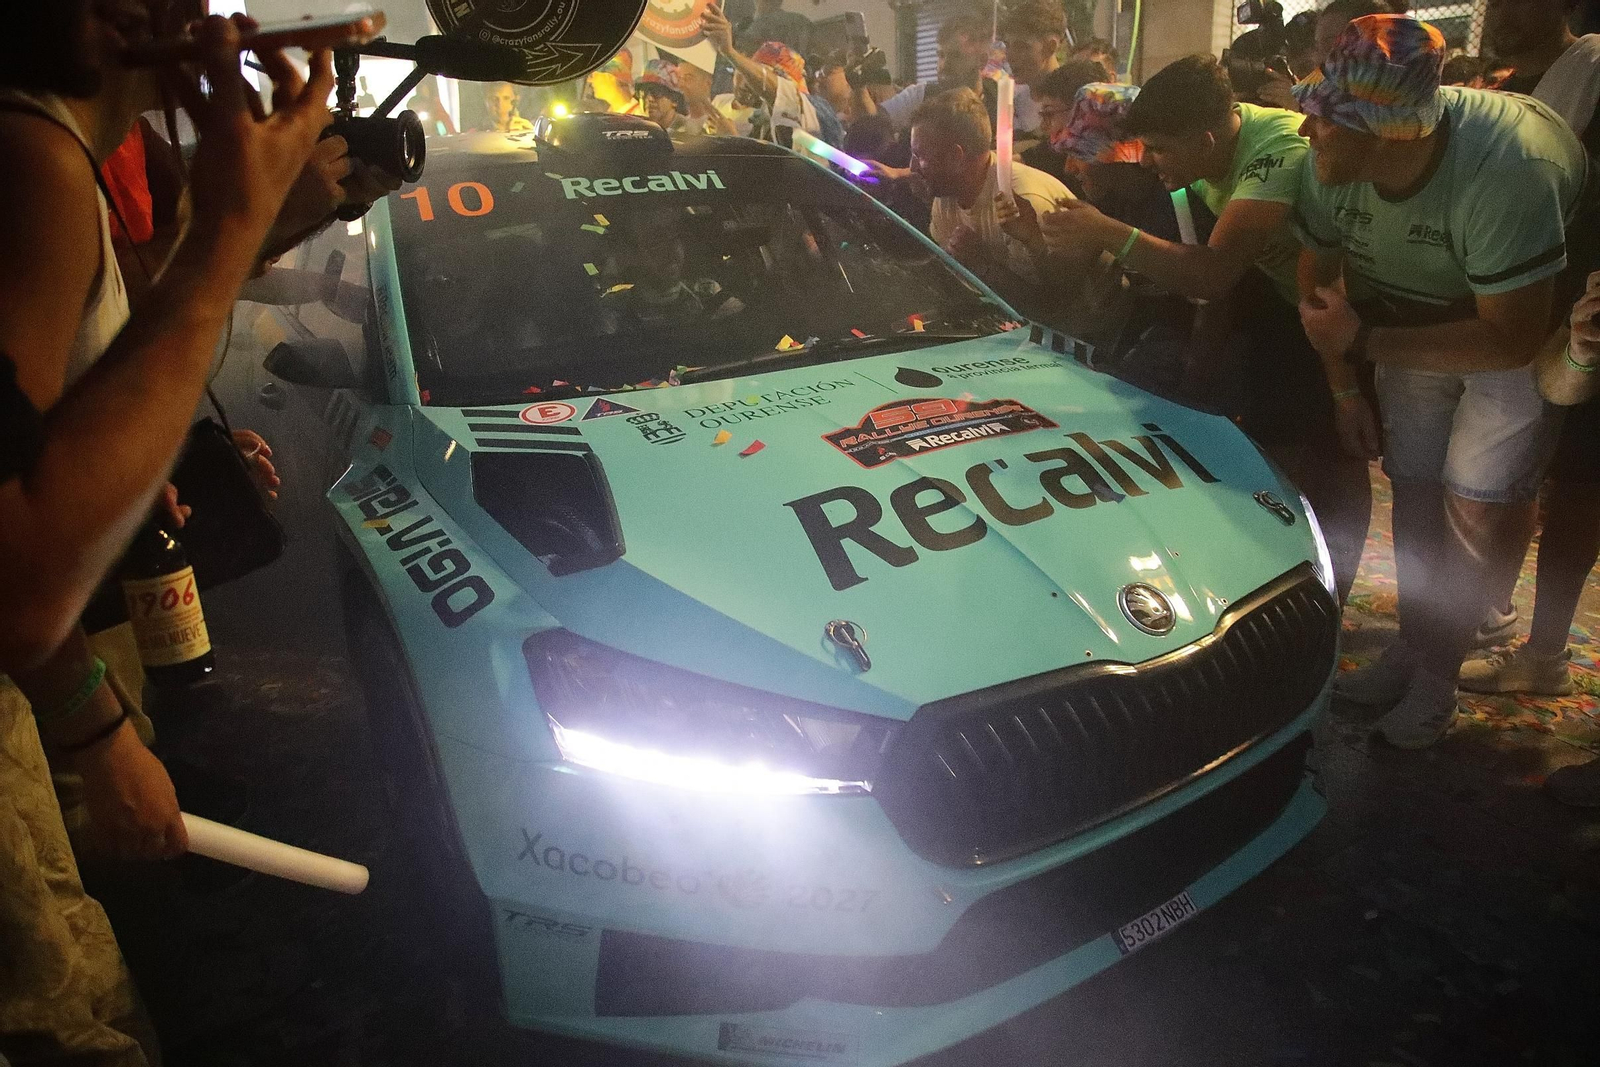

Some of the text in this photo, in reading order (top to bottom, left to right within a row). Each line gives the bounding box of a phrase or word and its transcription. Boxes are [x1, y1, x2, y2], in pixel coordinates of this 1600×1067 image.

[560, 170, 727, 200] Recalvi
[400, 182, 495, 222] 10
[931, 357, 1030, 374] ourense
[537, 405, 561, 418] E
[700, 395, 832, 429] OURENSE
[868, 400, 958, 429] 59
[840, 420, 930, 448] RALLYE
[924, 424, 995, 448] Recalvi
[784, 422, 1221, 591] Recalvi
[516, 827, 701, 896] Xacobeo
[502, 908, 593, 937] TRS
